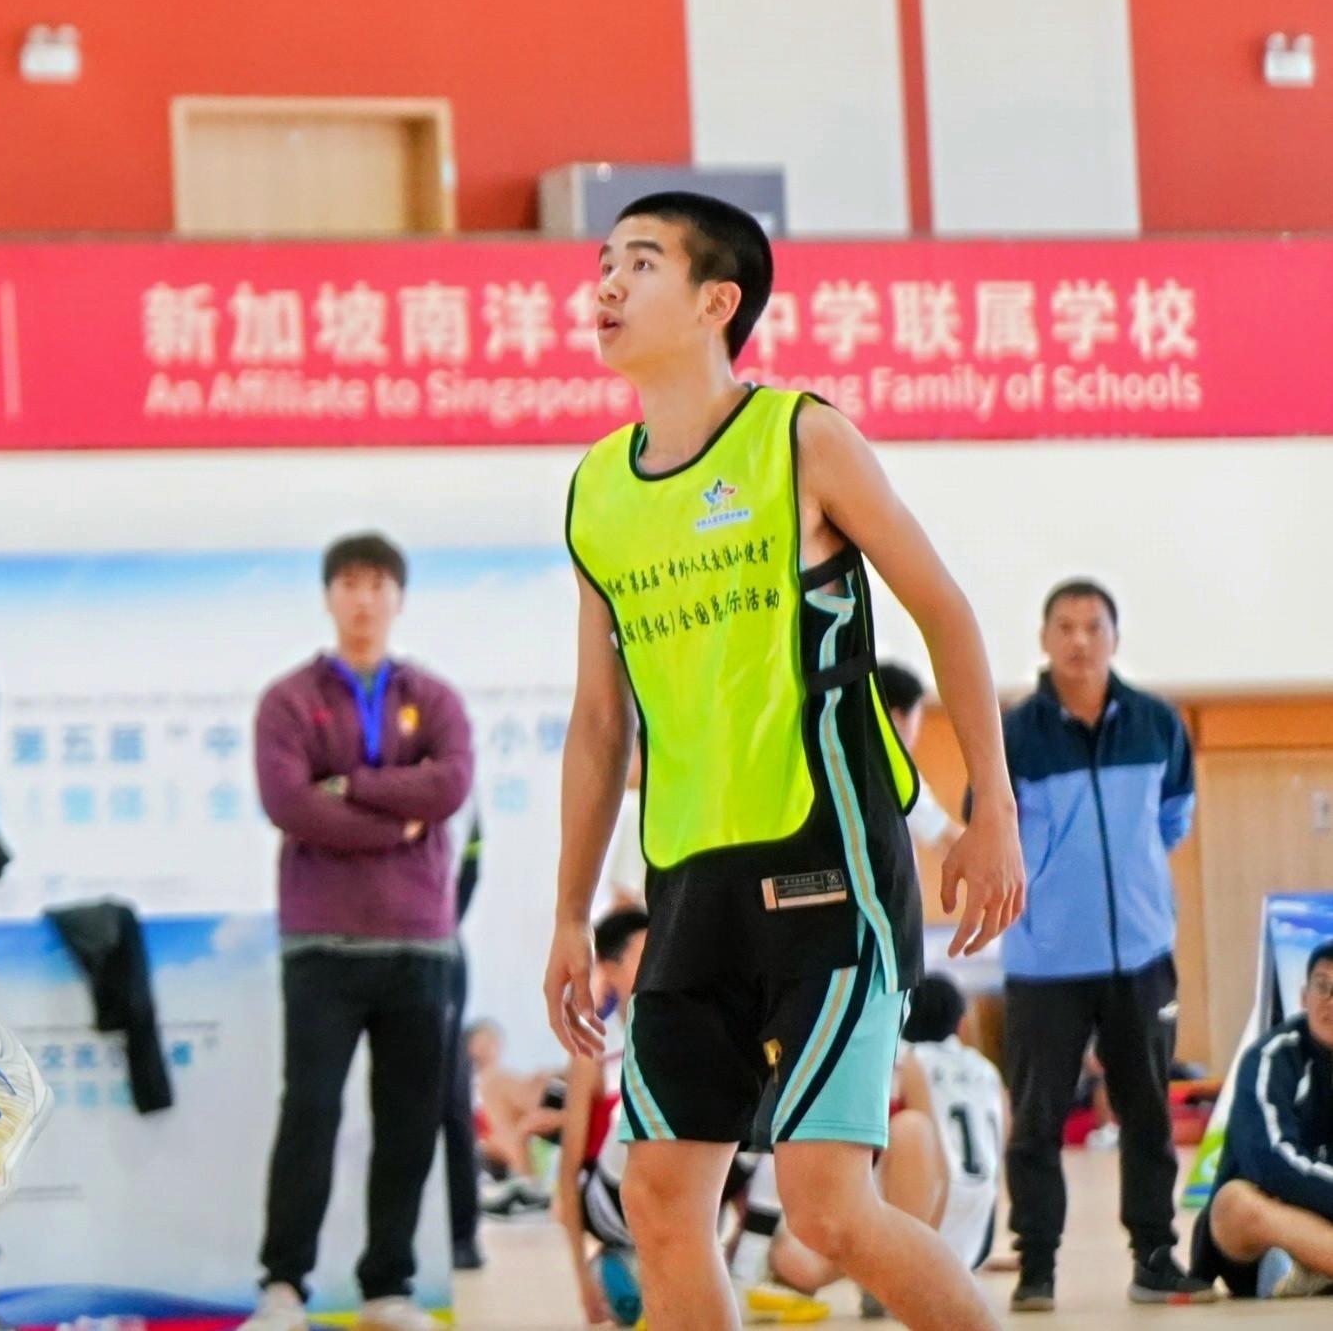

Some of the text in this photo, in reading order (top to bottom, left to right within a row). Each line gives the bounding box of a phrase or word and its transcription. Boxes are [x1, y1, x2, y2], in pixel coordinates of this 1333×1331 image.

[143, 372, 203, 416] An
[374, 372, 420, 416] to
[427, 367, 629, 425] Singapore
[871, 366, 996, 420] Family
[1005, 364, 1046, 411] of
[1053, 365, 1202, 411] Schools
